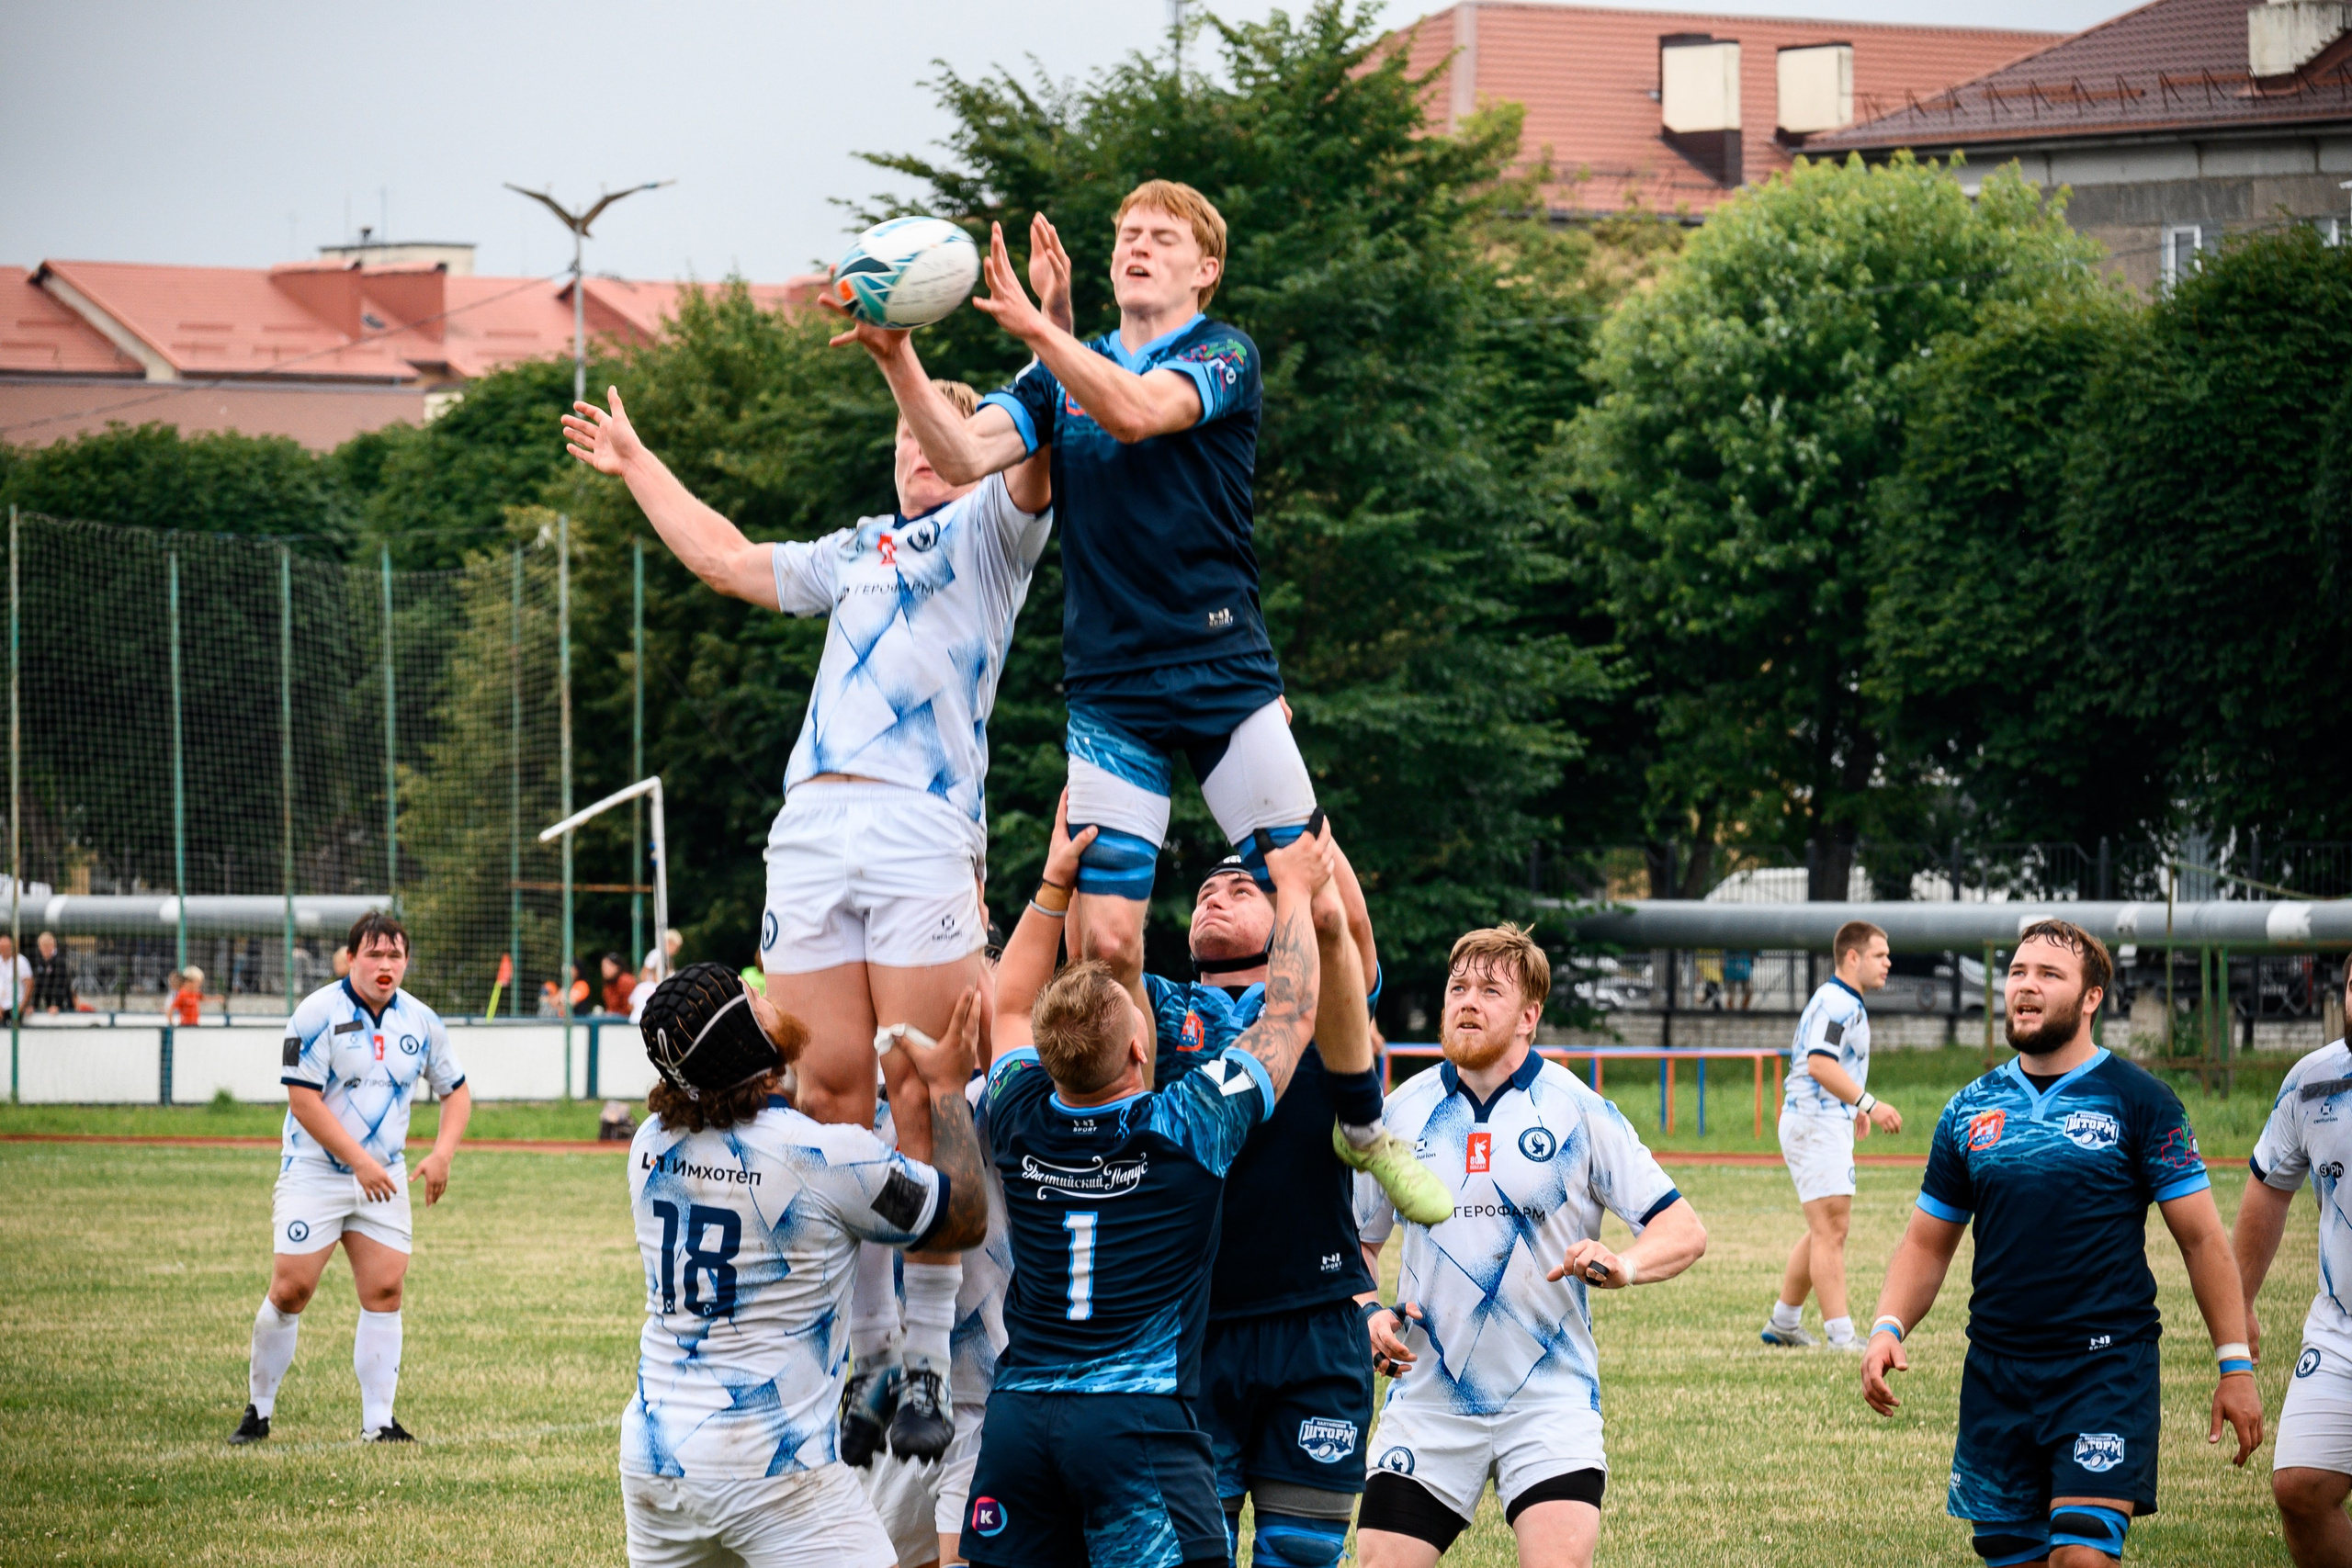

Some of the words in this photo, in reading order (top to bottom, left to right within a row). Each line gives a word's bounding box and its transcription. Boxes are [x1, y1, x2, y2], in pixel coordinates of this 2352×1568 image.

[2067, 1117, 2116, 1140] ШТОРМ
[673, 1157, 762, 1186] Имхотеп
[1022, 1155, 1103, 1189] Балтийский
[1103, 1152, 1148, 1190] Парус
[1453, 1205, 1546, 1223] ГЕРОФАРМ
[652, 1199, 741, 1316] 18
[1063, 1212, 1098, 1320] 1
[1302, 1424, 1355, 1449] ШТОРМ
[2076, 1440, 2122, 1458] ШТОРМ
[980, 1509, 993, 1525] K
